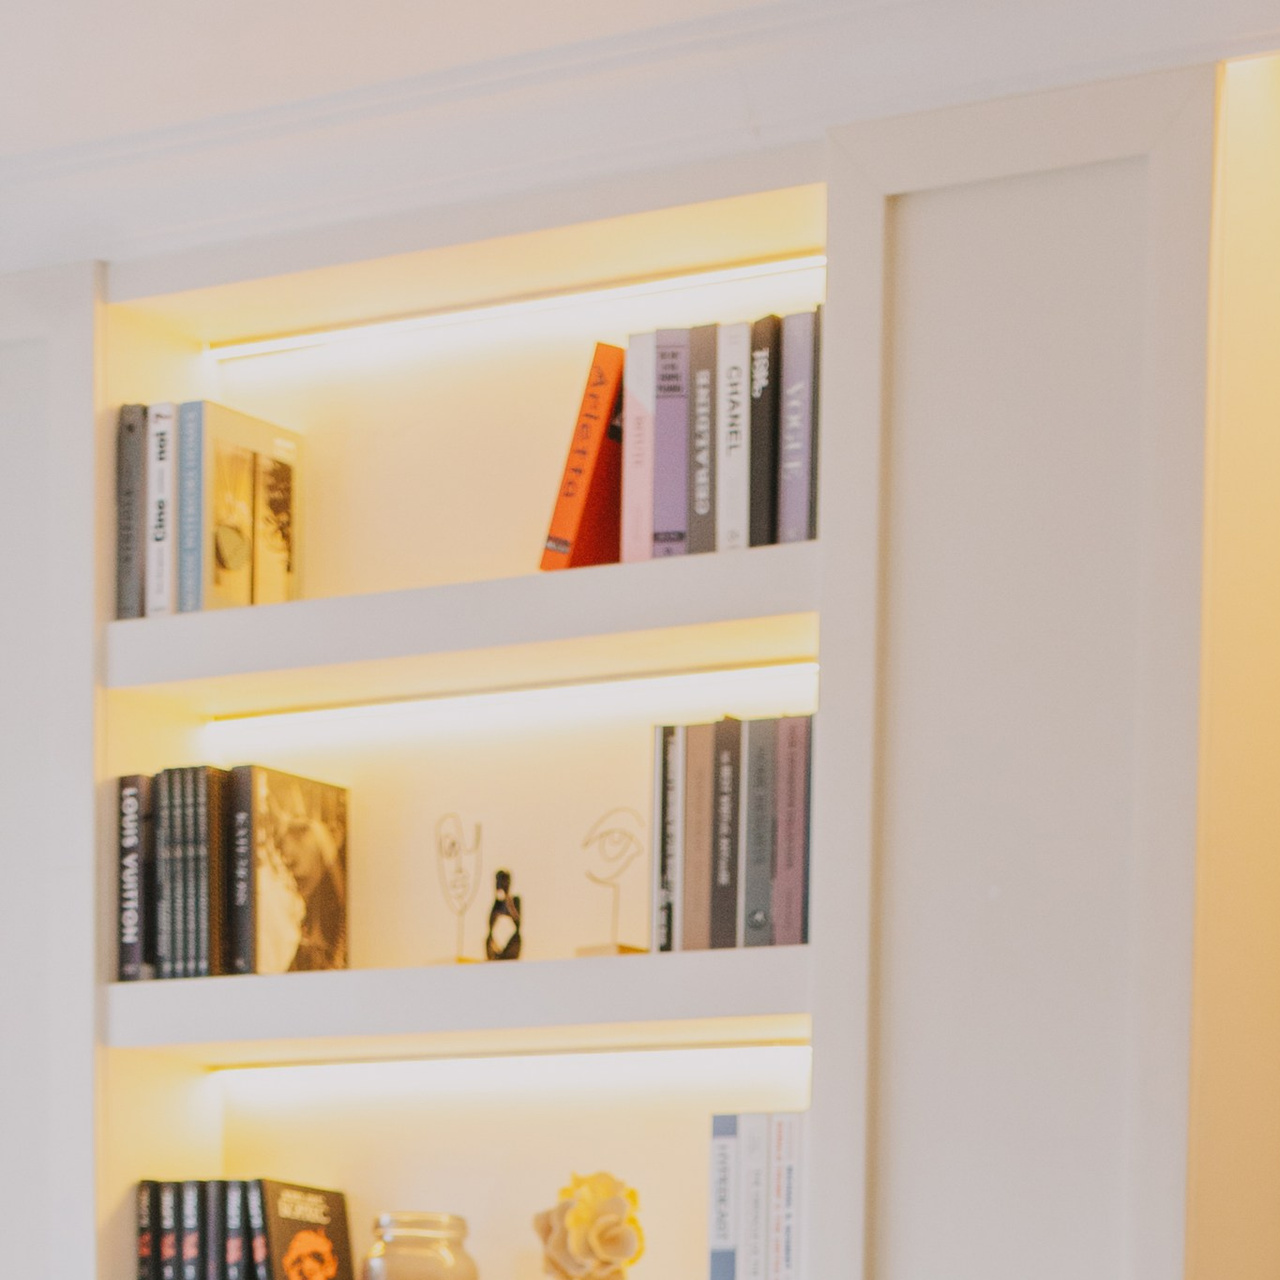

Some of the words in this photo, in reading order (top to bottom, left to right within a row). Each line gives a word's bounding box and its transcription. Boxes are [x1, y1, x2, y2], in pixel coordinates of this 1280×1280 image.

[726, 366, 742, 457] CHANEL
[783, 381, 805, 484] VOGUE
[121, 787, 138, 848] LOUIS
[121, 852, 138, 945] VUITTON
